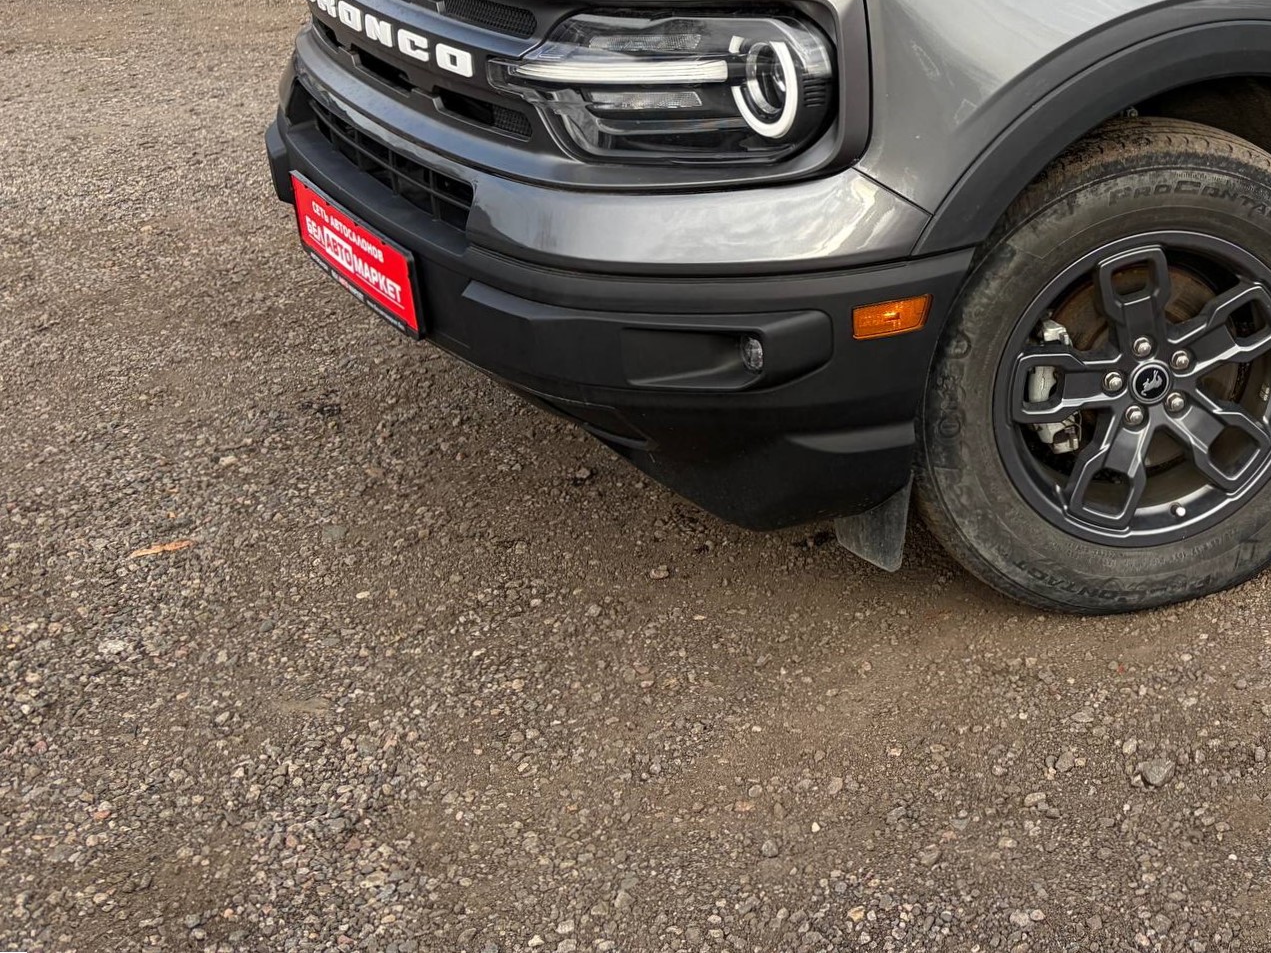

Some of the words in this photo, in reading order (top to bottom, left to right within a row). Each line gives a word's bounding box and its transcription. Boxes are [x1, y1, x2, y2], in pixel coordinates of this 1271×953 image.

[305, 215, 325, 245] БЕЛ
[326, 231, 353, 267] АВТО
[353, 254, 402, 303] МАРКЕТ
[312, 201, 329, 224] СЕТЬ
[330, 215, 384, 264] АВТОСАЛОНОВ
